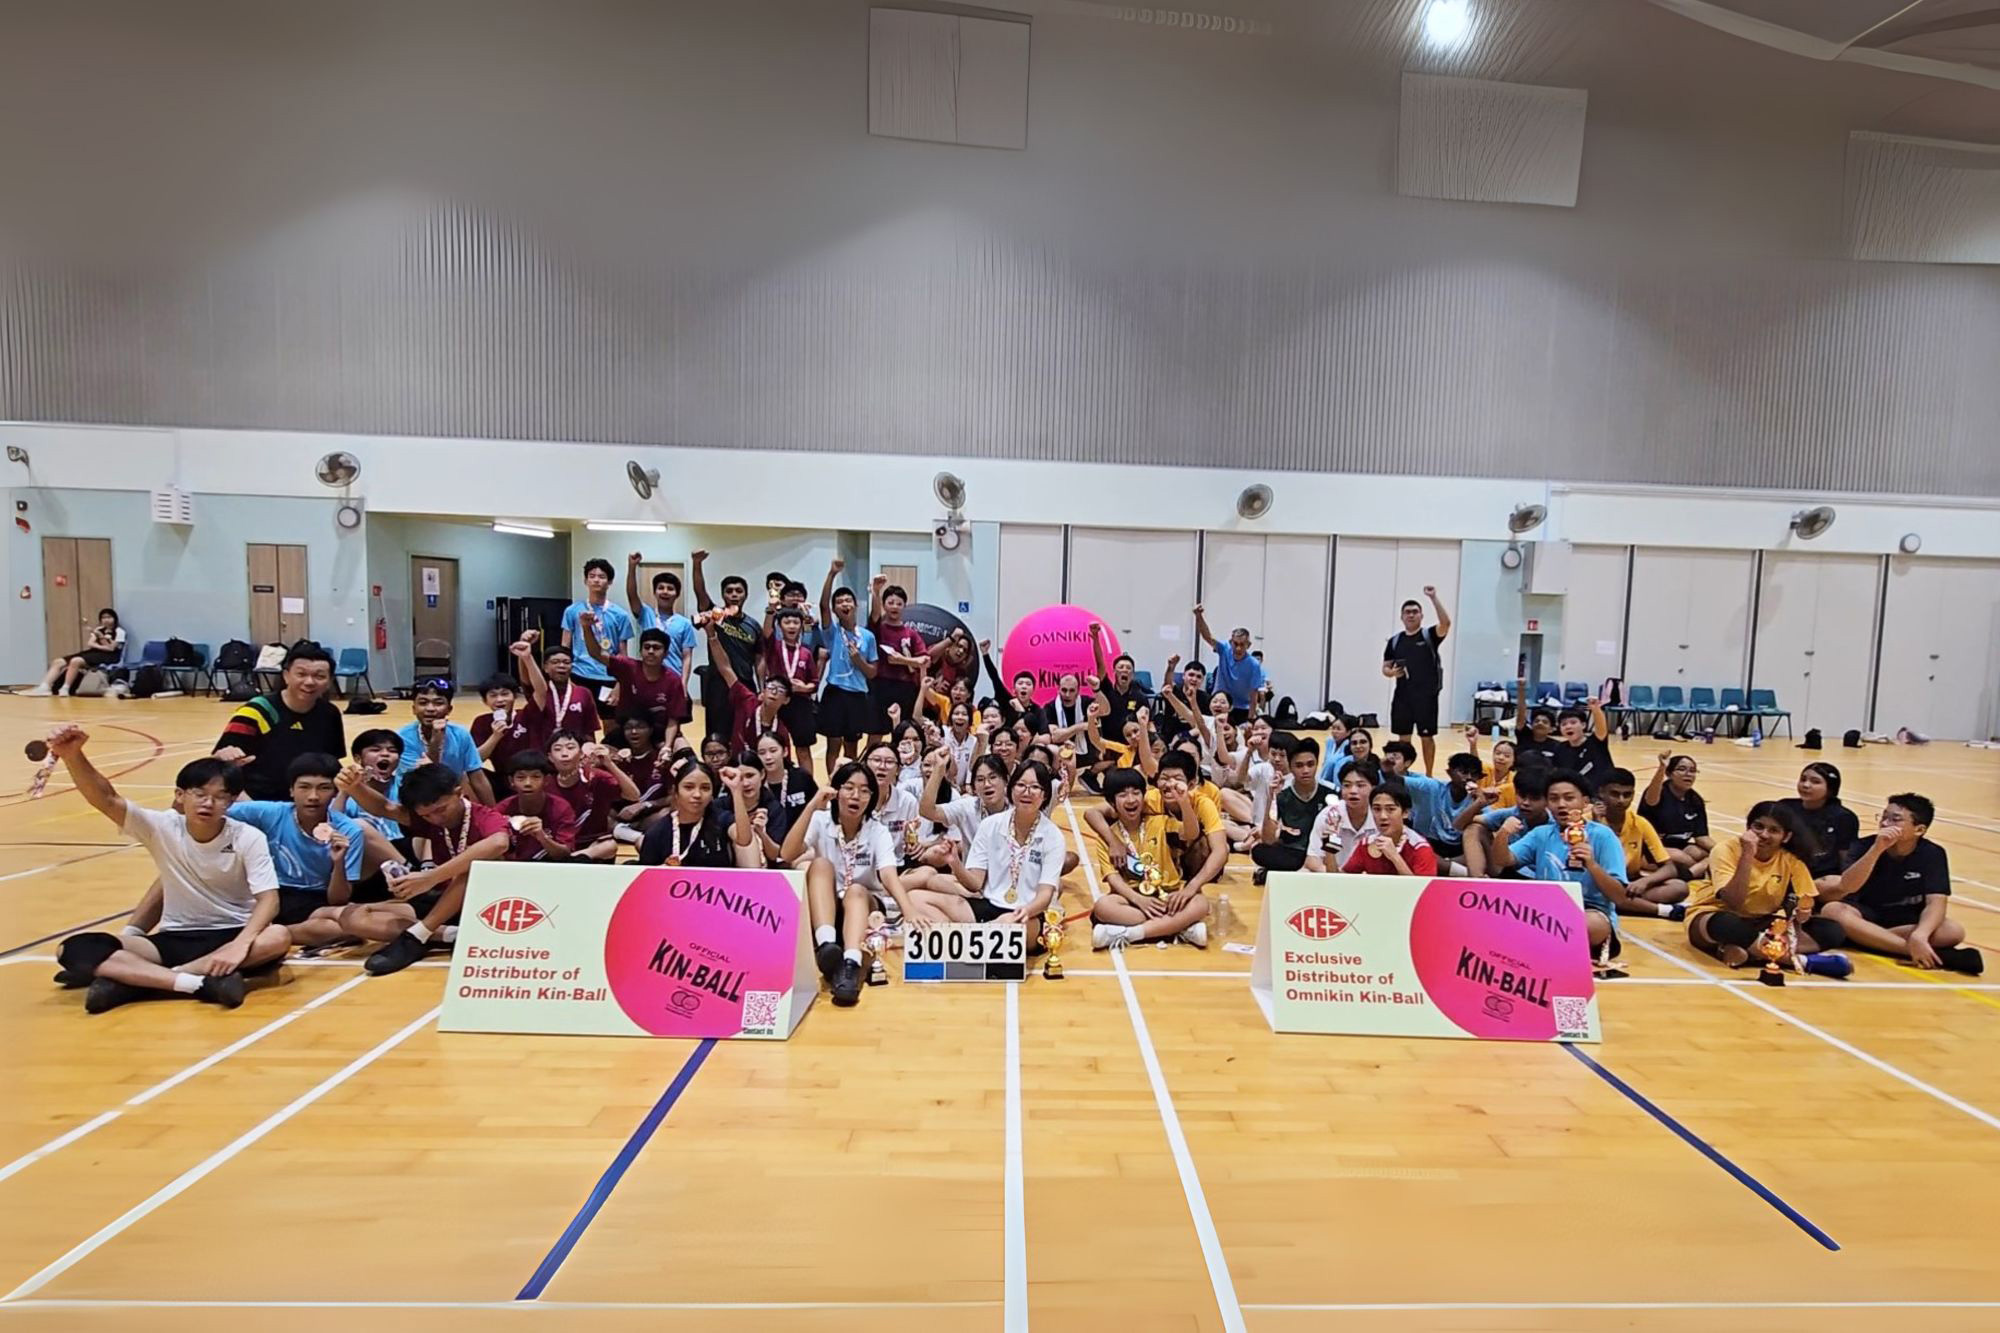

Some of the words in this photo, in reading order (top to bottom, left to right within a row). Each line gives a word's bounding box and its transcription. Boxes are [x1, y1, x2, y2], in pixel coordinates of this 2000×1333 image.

[479, 898, 546, 934] ACES
[669, 880, 781, 934] OMNIKIN
[1458, 890, 1569, 943] OMNIKIN
[1288, 907, 1349, 940] ACES
[467, 945, 550, 961] Exclusive
[689, 942, 731, 963] OFFICIAL
[908, 930, 1023, 960] 300525
[647, 938, 747, 1003] KIN-BALL
[1284, 951, 1363, 966] Exclusive
[462, 965, 558, 981] Distributor
[562, 966, 581, 981] of
[1285, 970, 1374, 985] Distributor
[1378, 972, 1394, 986] of
[1456, 946, 1551, 1009] KIN-BALL
[458, 985, 531, 1000] Omnikin
[537, 986, 607, 1002] Kin-Ball
[1286, 988, 1354, 1004] Omnikin
[1359, 990, 1424, 1006] Kin-Ball
